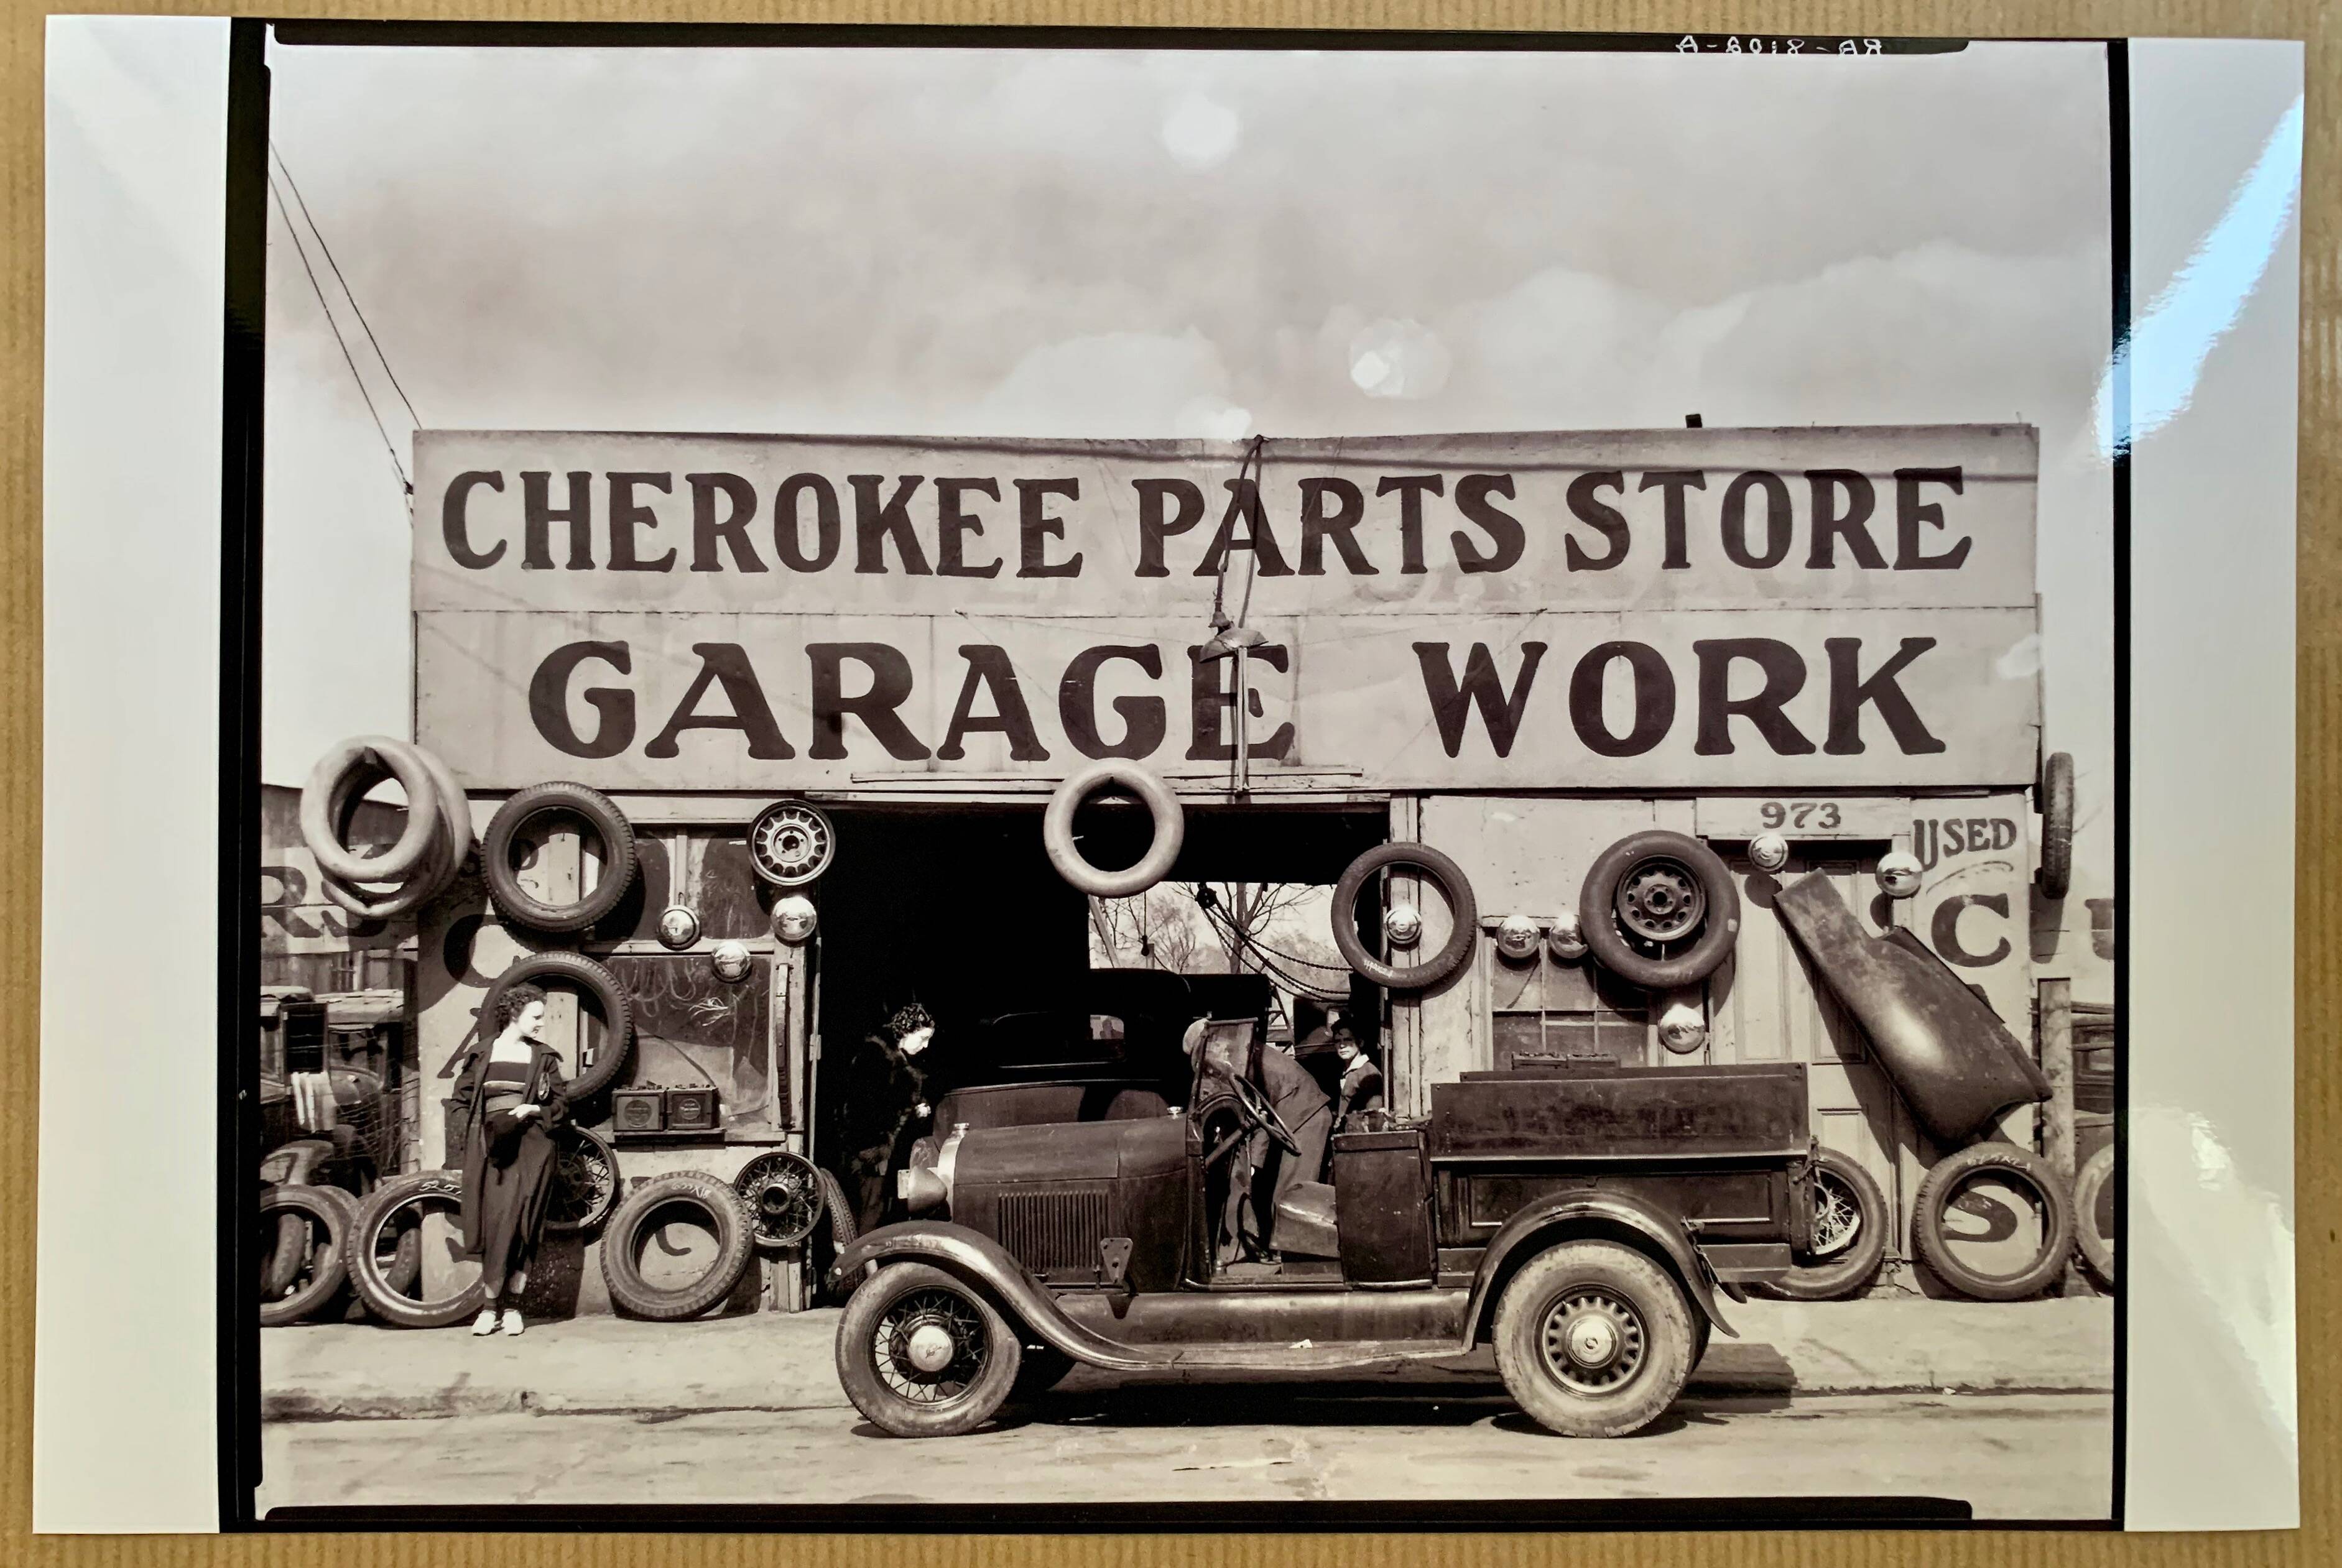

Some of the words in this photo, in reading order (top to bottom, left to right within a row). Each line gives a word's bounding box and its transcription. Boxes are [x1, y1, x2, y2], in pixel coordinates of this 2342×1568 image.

[442, 471, 1084, 578] CHEROKEE
[1132, 474, 1525, 577] PARTS
[1565, 466, 1972, 571] STORE
[528, 640, 1295, 762] GARAGE
[1412, 637, 1946, 757] WORK
[1760, 801, 1841, 829] 973
[1913, 818, 2017, 870] USED
